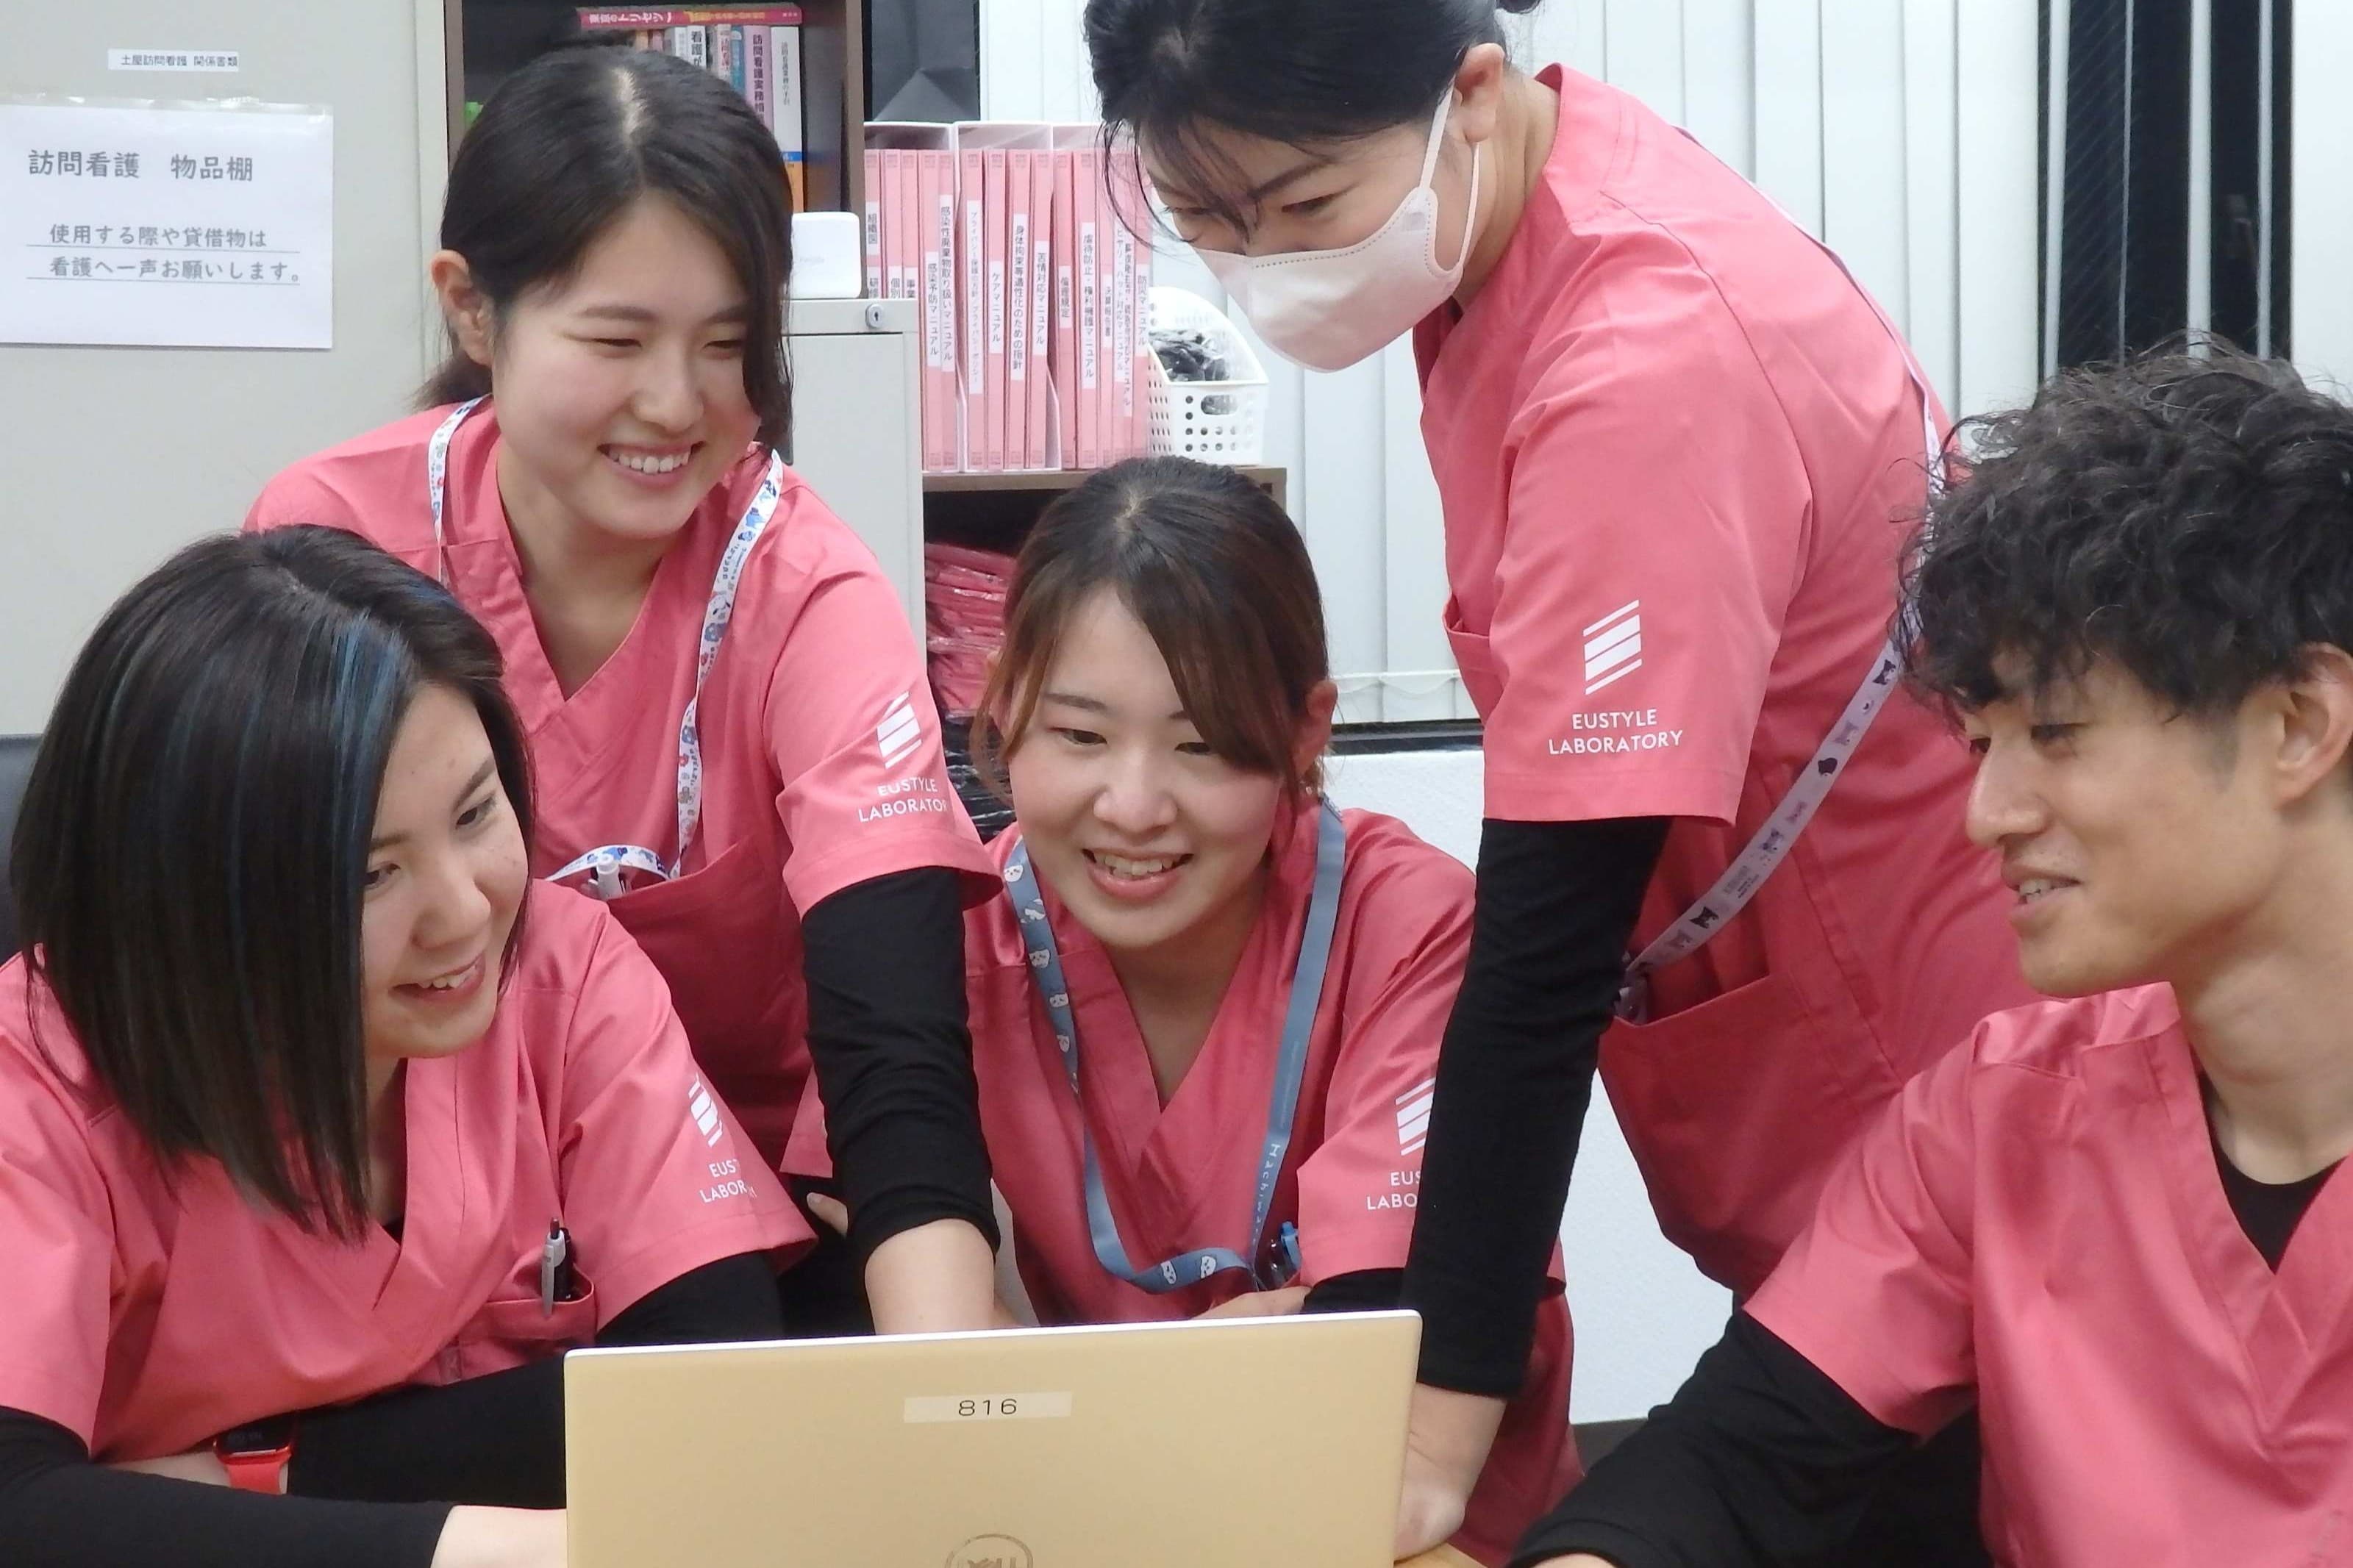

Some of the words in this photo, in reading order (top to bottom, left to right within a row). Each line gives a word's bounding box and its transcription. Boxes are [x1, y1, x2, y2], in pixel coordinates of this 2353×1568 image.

[121, 54, 188, 66] 土屋訪問看護
[193, 55, 238, 66] 関係書類
[28, 149, 140, 179] 訪問看護
[171, 154, 253, 182] 物品棚
[50, 223, 267, 248] 使用する際や貸借物は
[868, 213, 877, 245] 組織図
[50, 257, 299, 282] 看護へ一声お願いします。
[890, 278, 900, 298] 個別
[1036, 252, 1046, 345] 苦情対応マニュアル
[928, 263, 939, 355] 感染予防マニュアル
[992, 273, 1001, 342] ケアマニュアル
[1137, 275, 1148, 346] 防災マニュアル
[1572, 709, 1657, 730] EUSTYLE
[1549, 730, 1683, 755] LABORATORY
[877, 777, 938, 797] EUSTYLE
[708, 1159, 738, 1178] EUS
[699, 1179, 757, 1203] LABOR
[1367, 1193, 1418, 1210] LABO
[958, 1398, 1017, 1417] 816
